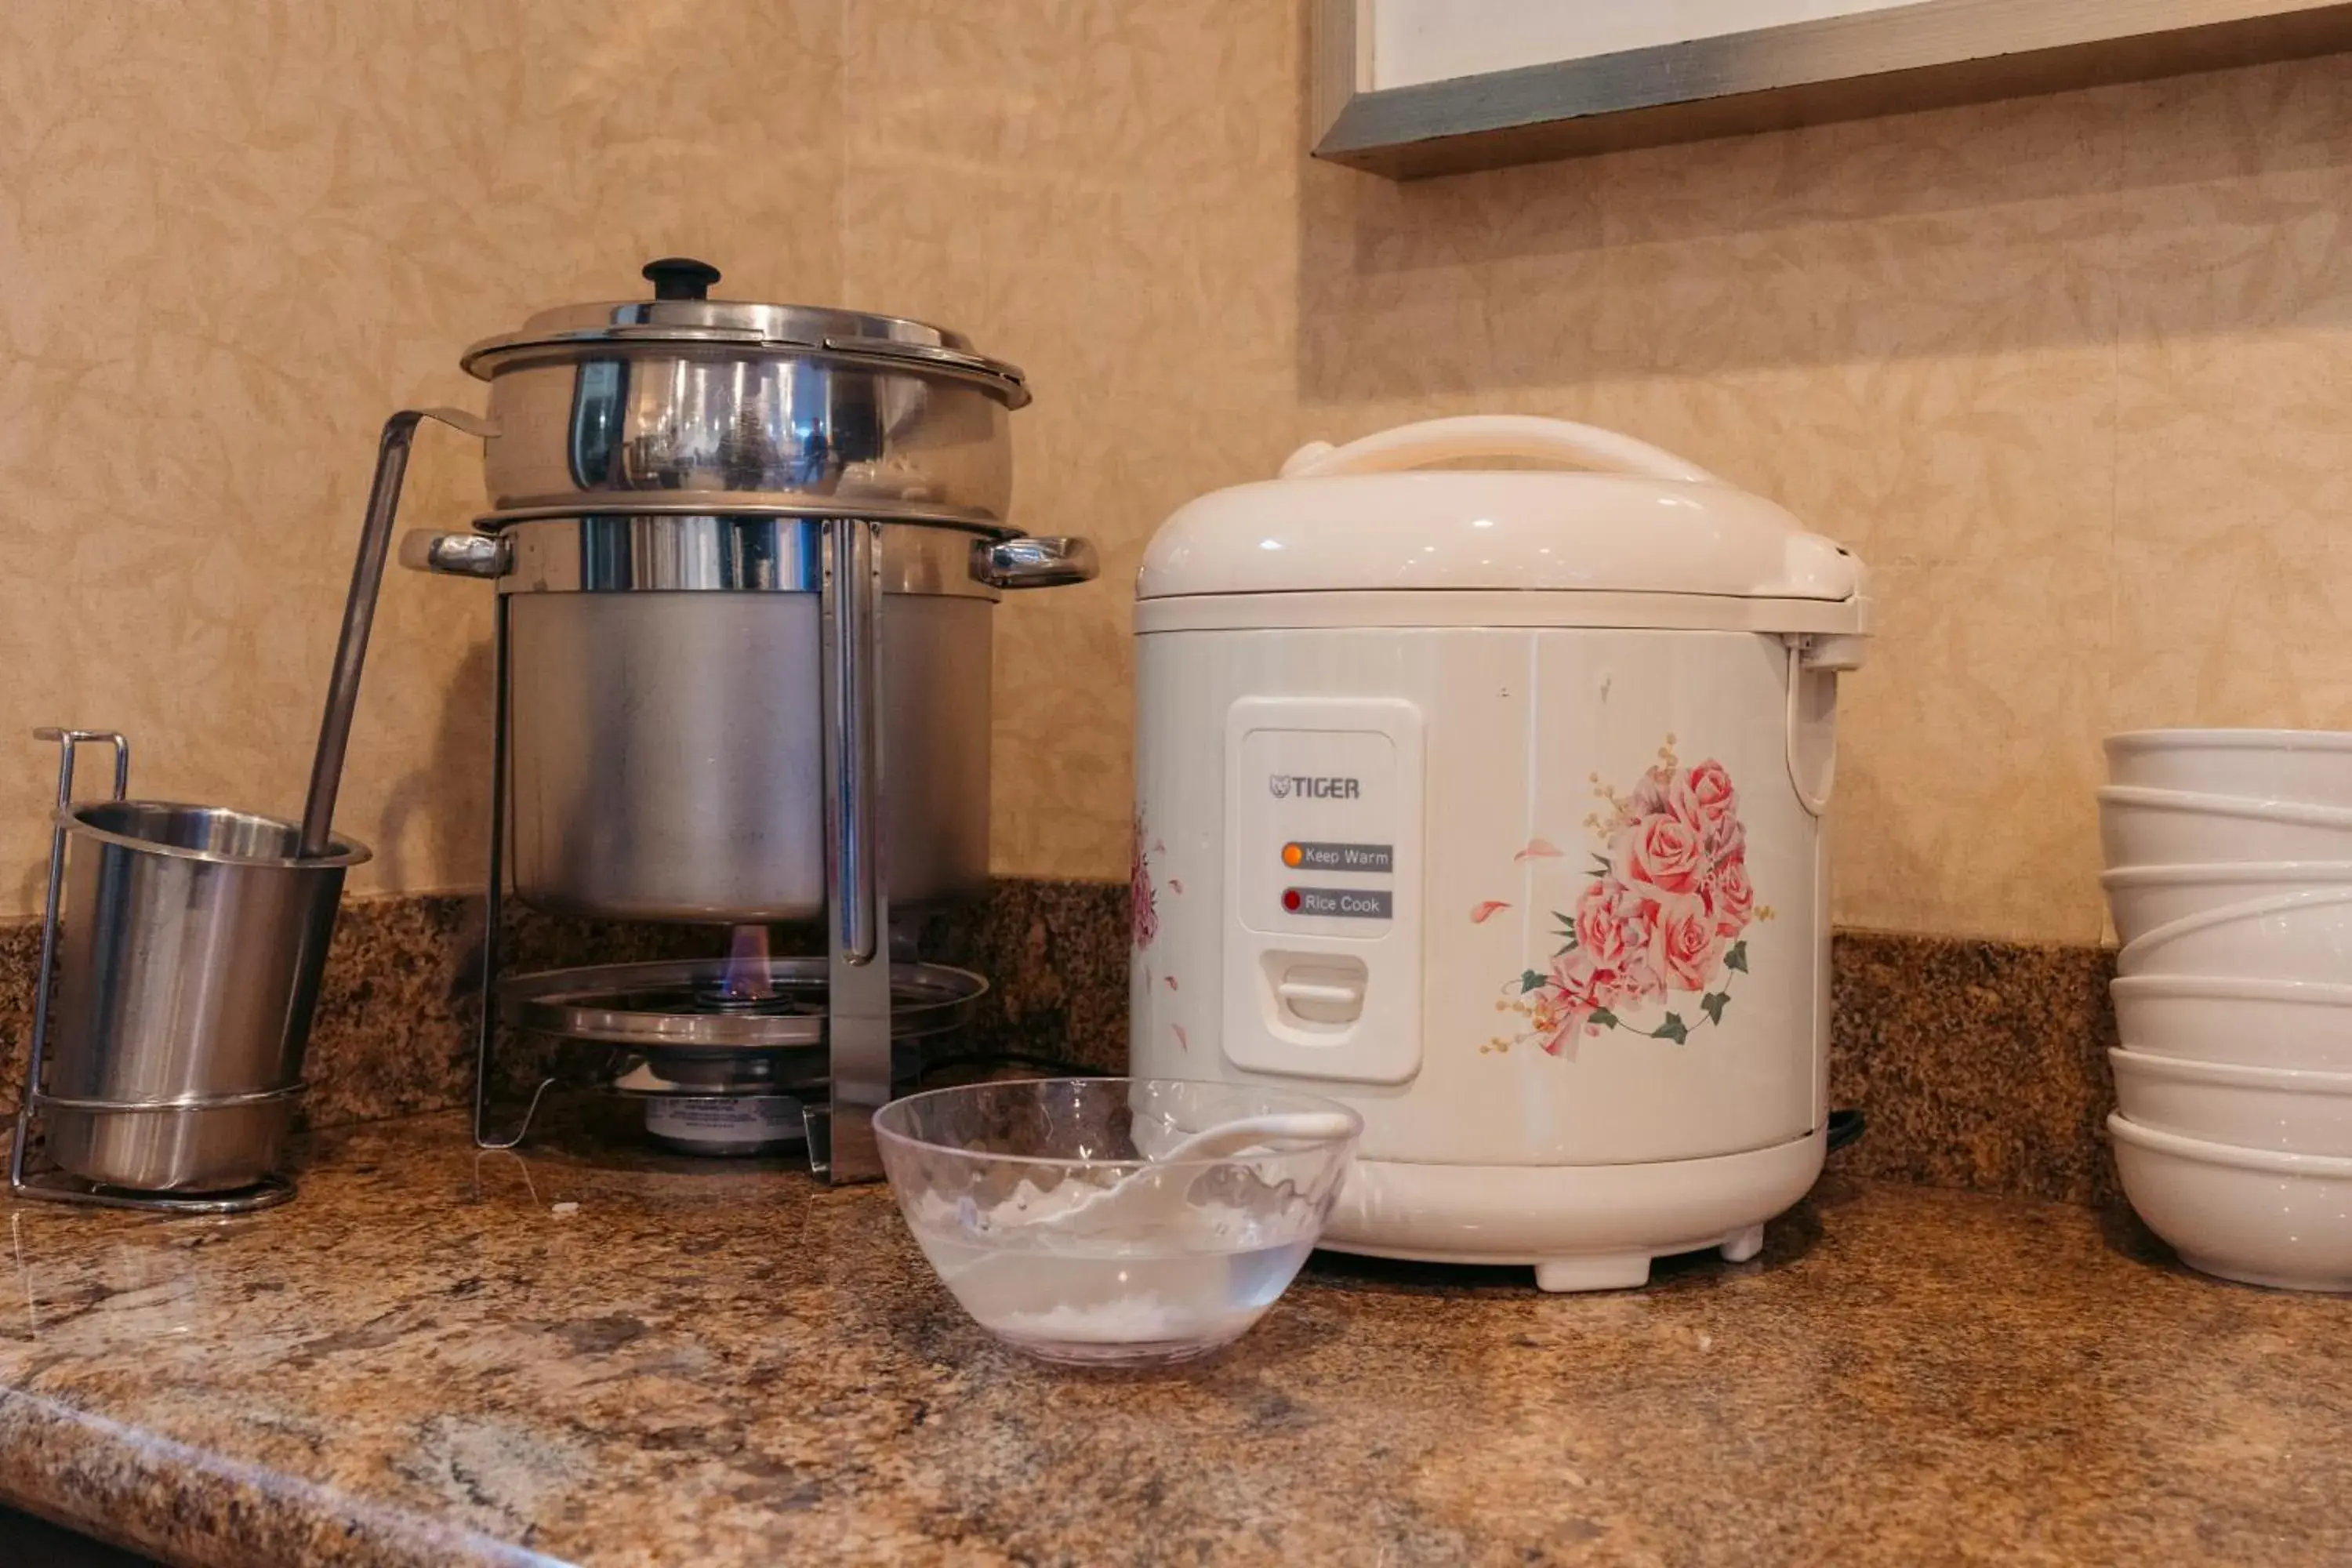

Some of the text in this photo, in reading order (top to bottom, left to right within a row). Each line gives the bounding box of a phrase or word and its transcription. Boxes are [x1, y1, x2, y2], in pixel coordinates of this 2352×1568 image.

[1292, 777, 1360, 799] TIGER
[1305, 848, 1388, 865] Keep Warm
[1305, 895, 1380, 912] Rice Cook
